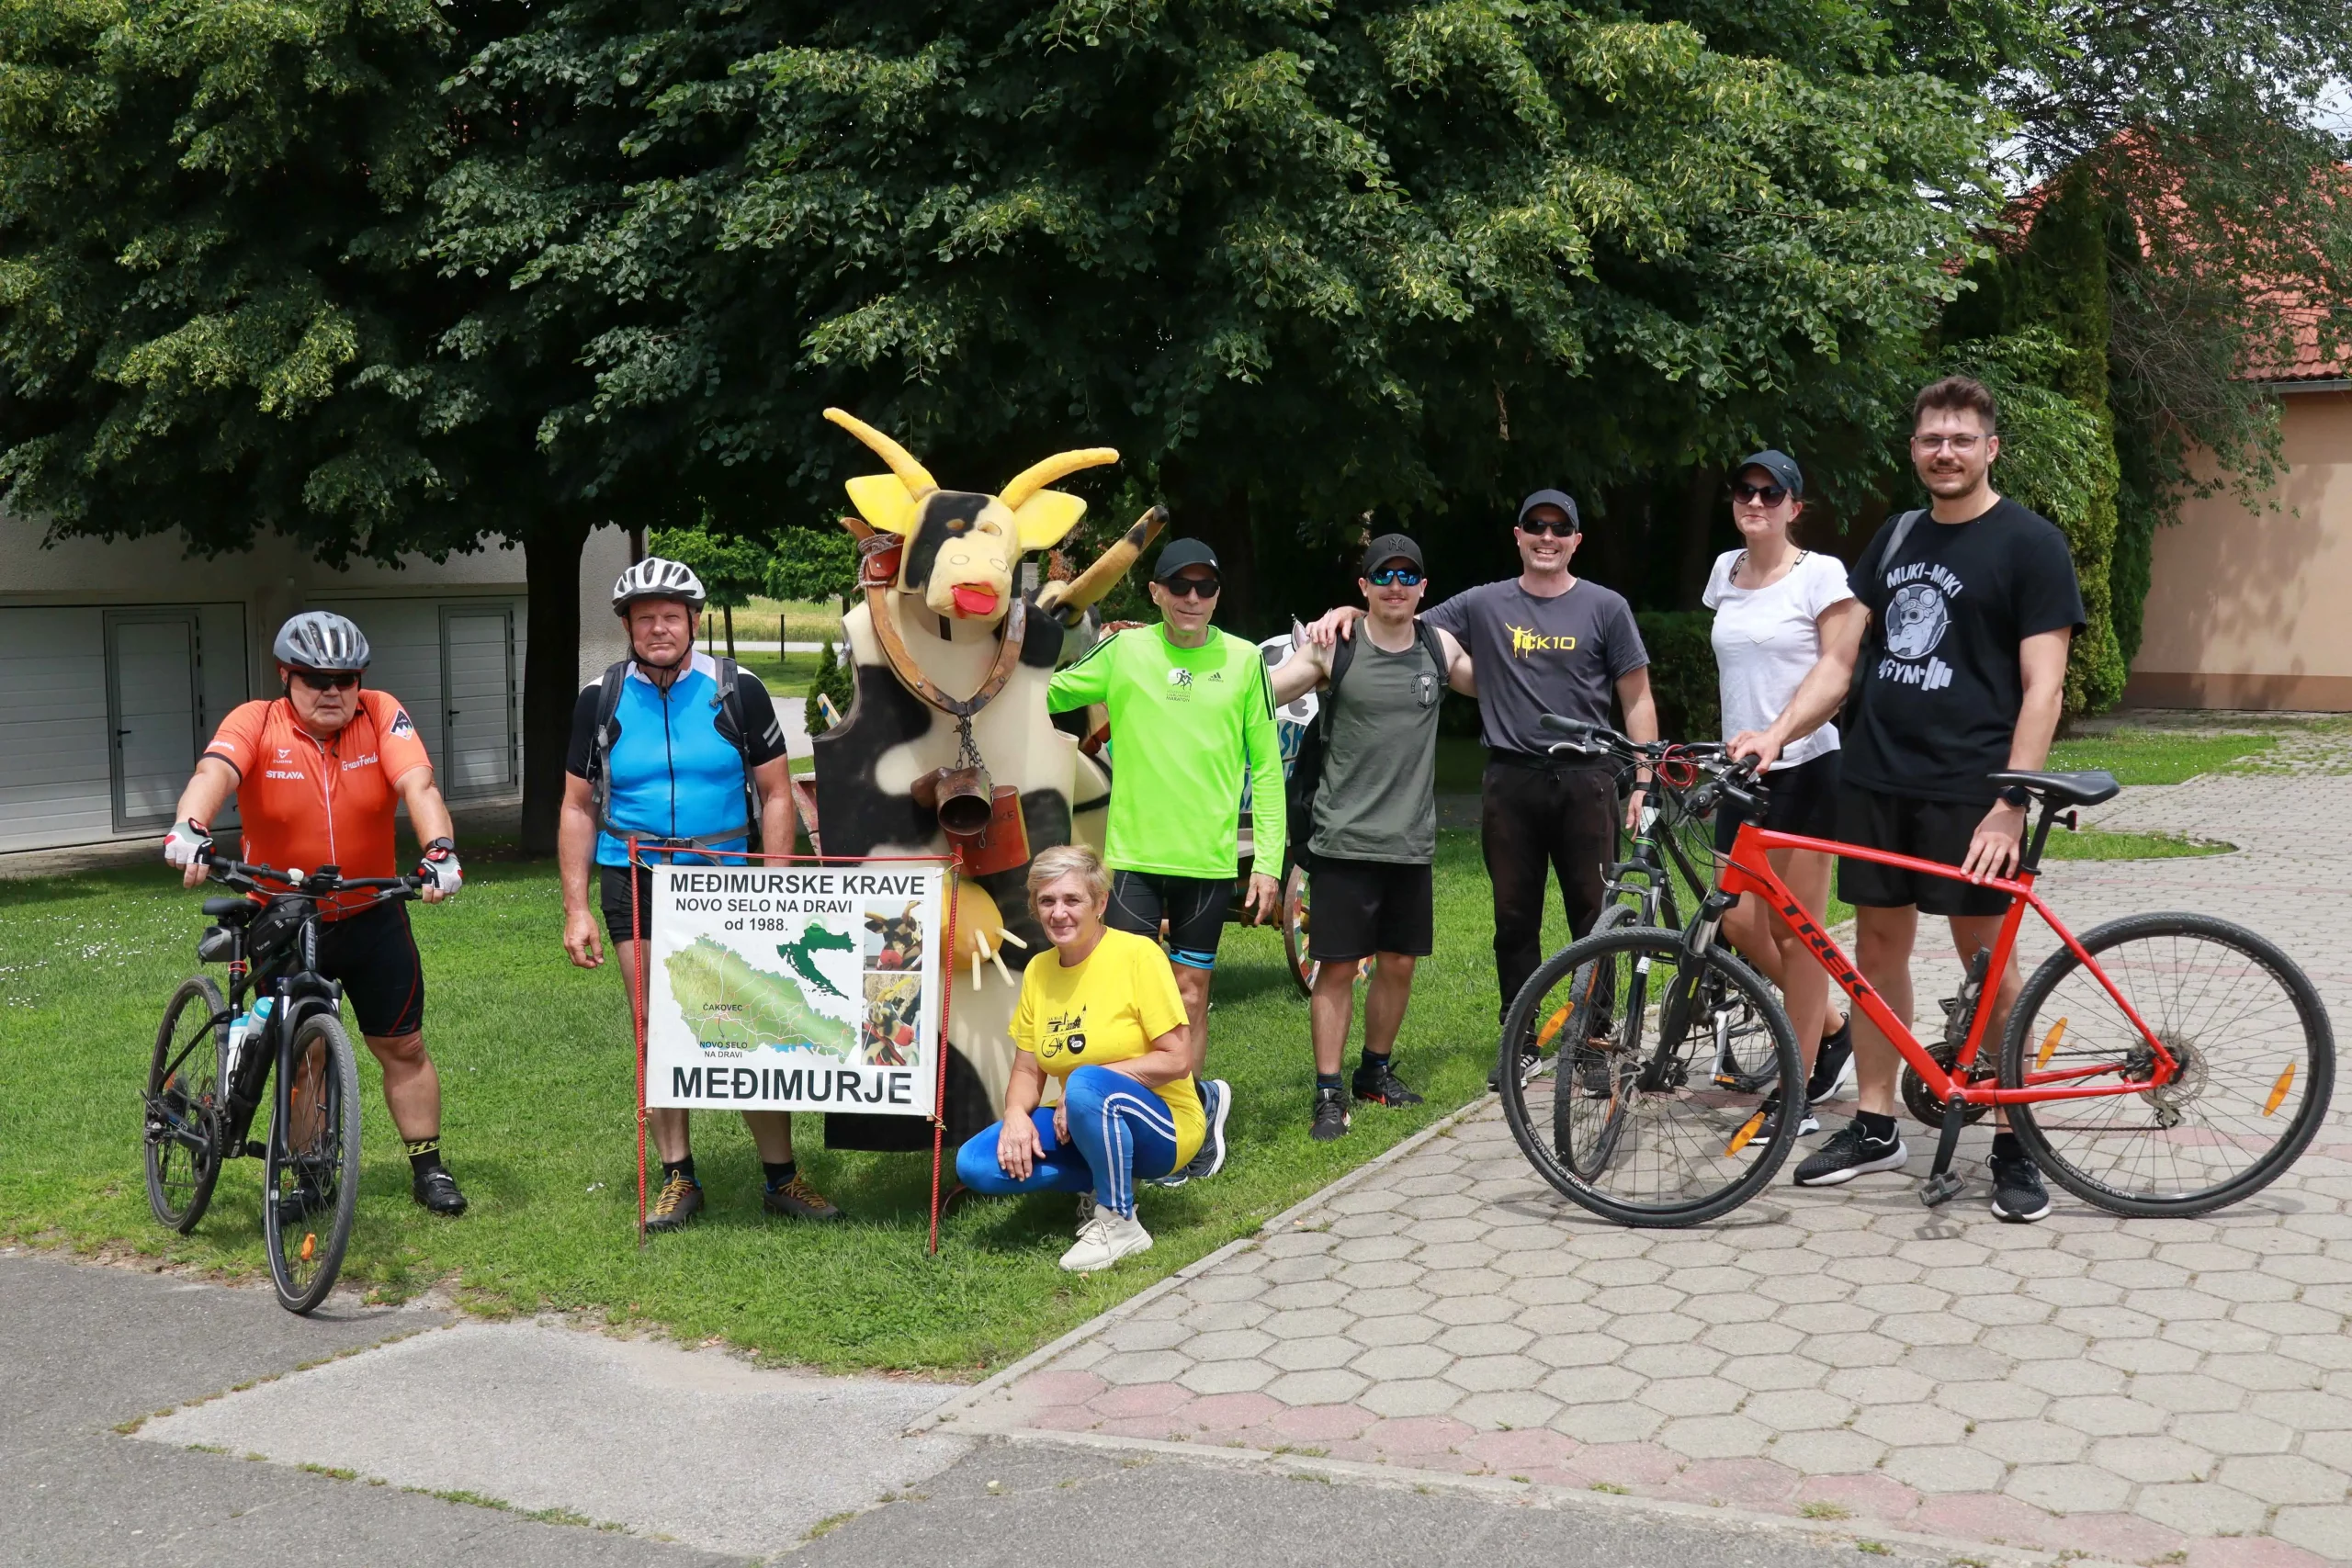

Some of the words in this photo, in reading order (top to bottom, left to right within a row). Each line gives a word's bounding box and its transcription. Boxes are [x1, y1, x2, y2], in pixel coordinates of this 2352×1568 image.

[1886, 562, 1963, 598] MUKI-MUKI
[1885, 659, 1920, 684] GYM
[266, 770, 305, 780] STRAVA
[670, 873, 834, 895] MEĐIMURSKE
[842, 874, 925, 896] KRAVE
[675, 897, 723, 912] NOVO
[727, 898, 771, 912] SELO
[775, 899, 799, 913] NA
[803, 899, 853, 914] DRAVI
[724, 918, 744, 931] od
[749, 918, 788, 931] 1988.
[1782, 895, 1873, 1001] TREK
[702, 1002, 743, 1011] ČAKOVEC
[699, 1041, 724, 1049] NOVO
[725, 1041, 748, 1049] SELO
[704, 1050, 717, 1058] NA
[673, 1066, 912, 1104] MEĐIMURJE
[1529, 1130, 1592, 1193] CONNECTION
[2055, 1156, 2135, 1200] CONNECTION
